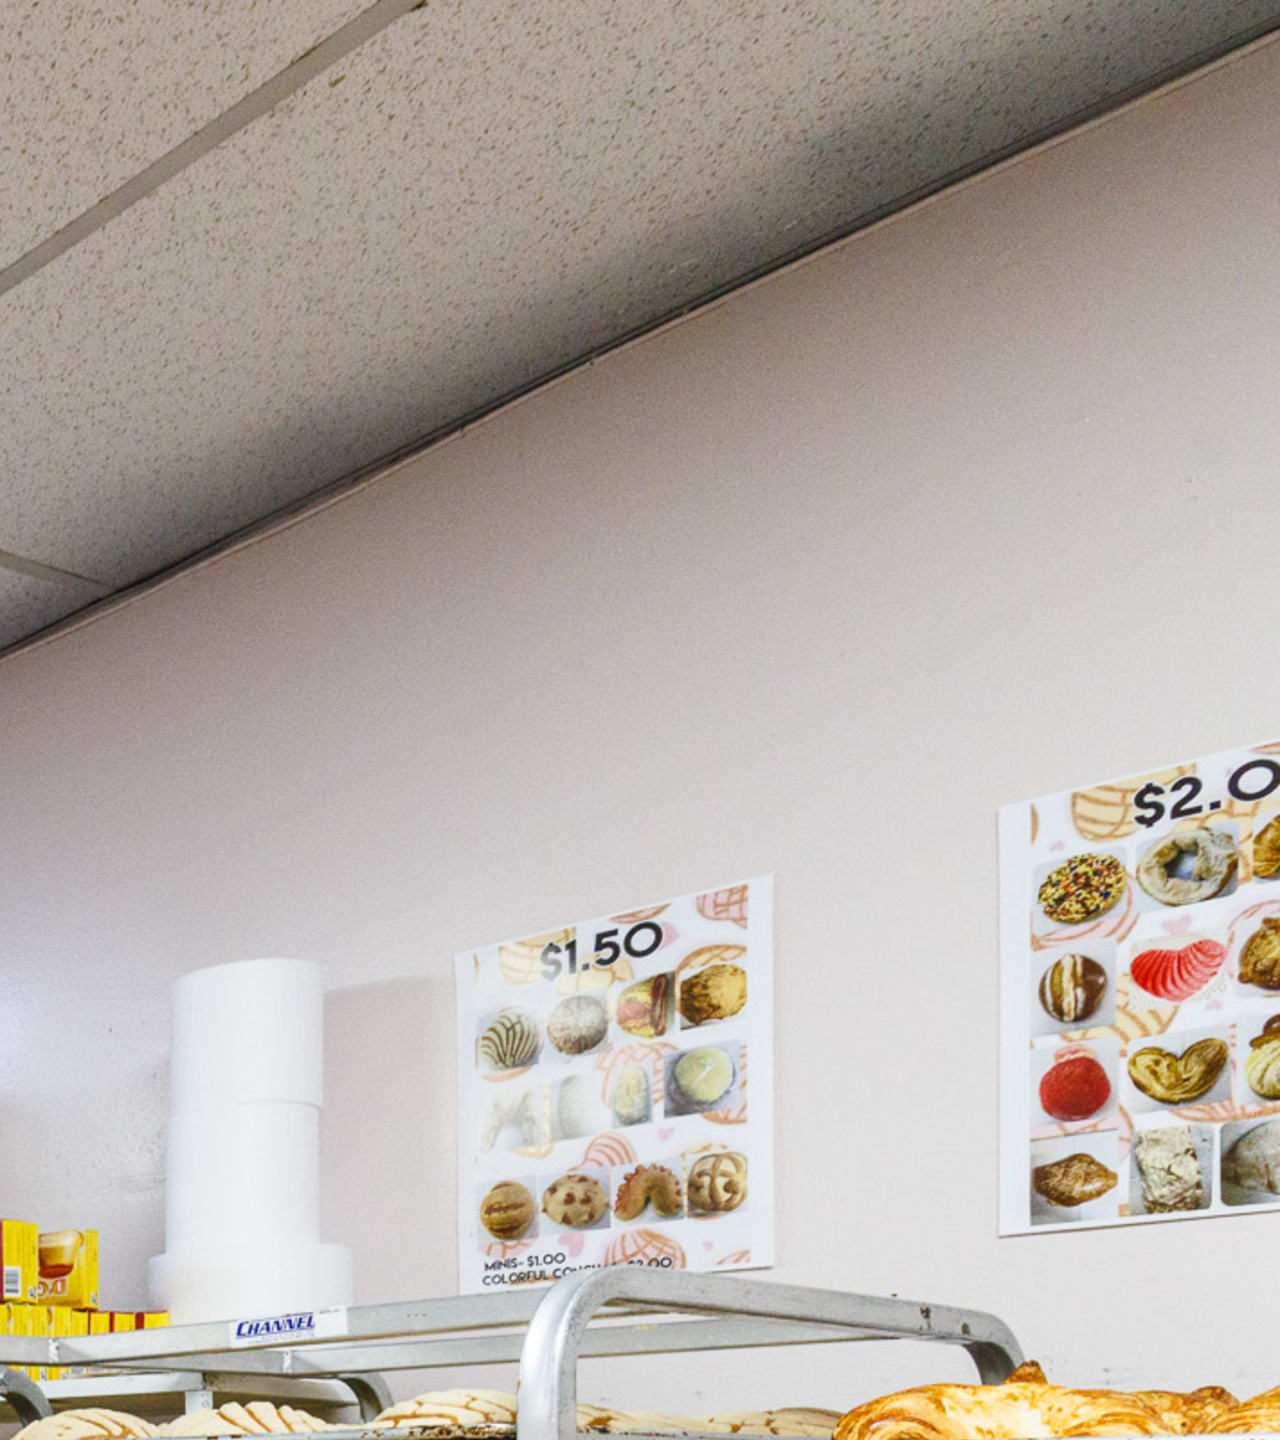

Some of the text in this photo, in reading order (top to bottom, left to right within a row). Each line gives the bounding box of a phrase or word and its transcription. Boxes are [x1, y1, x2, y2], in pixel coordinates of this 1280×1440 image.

[540, 920, 663, 982] $1.50
[526, 1252, 566, 1268] $1.00
[481, 1269, 549, 1286] COLORFUL
[236, 1315, 316, 1339] CHANNEL
